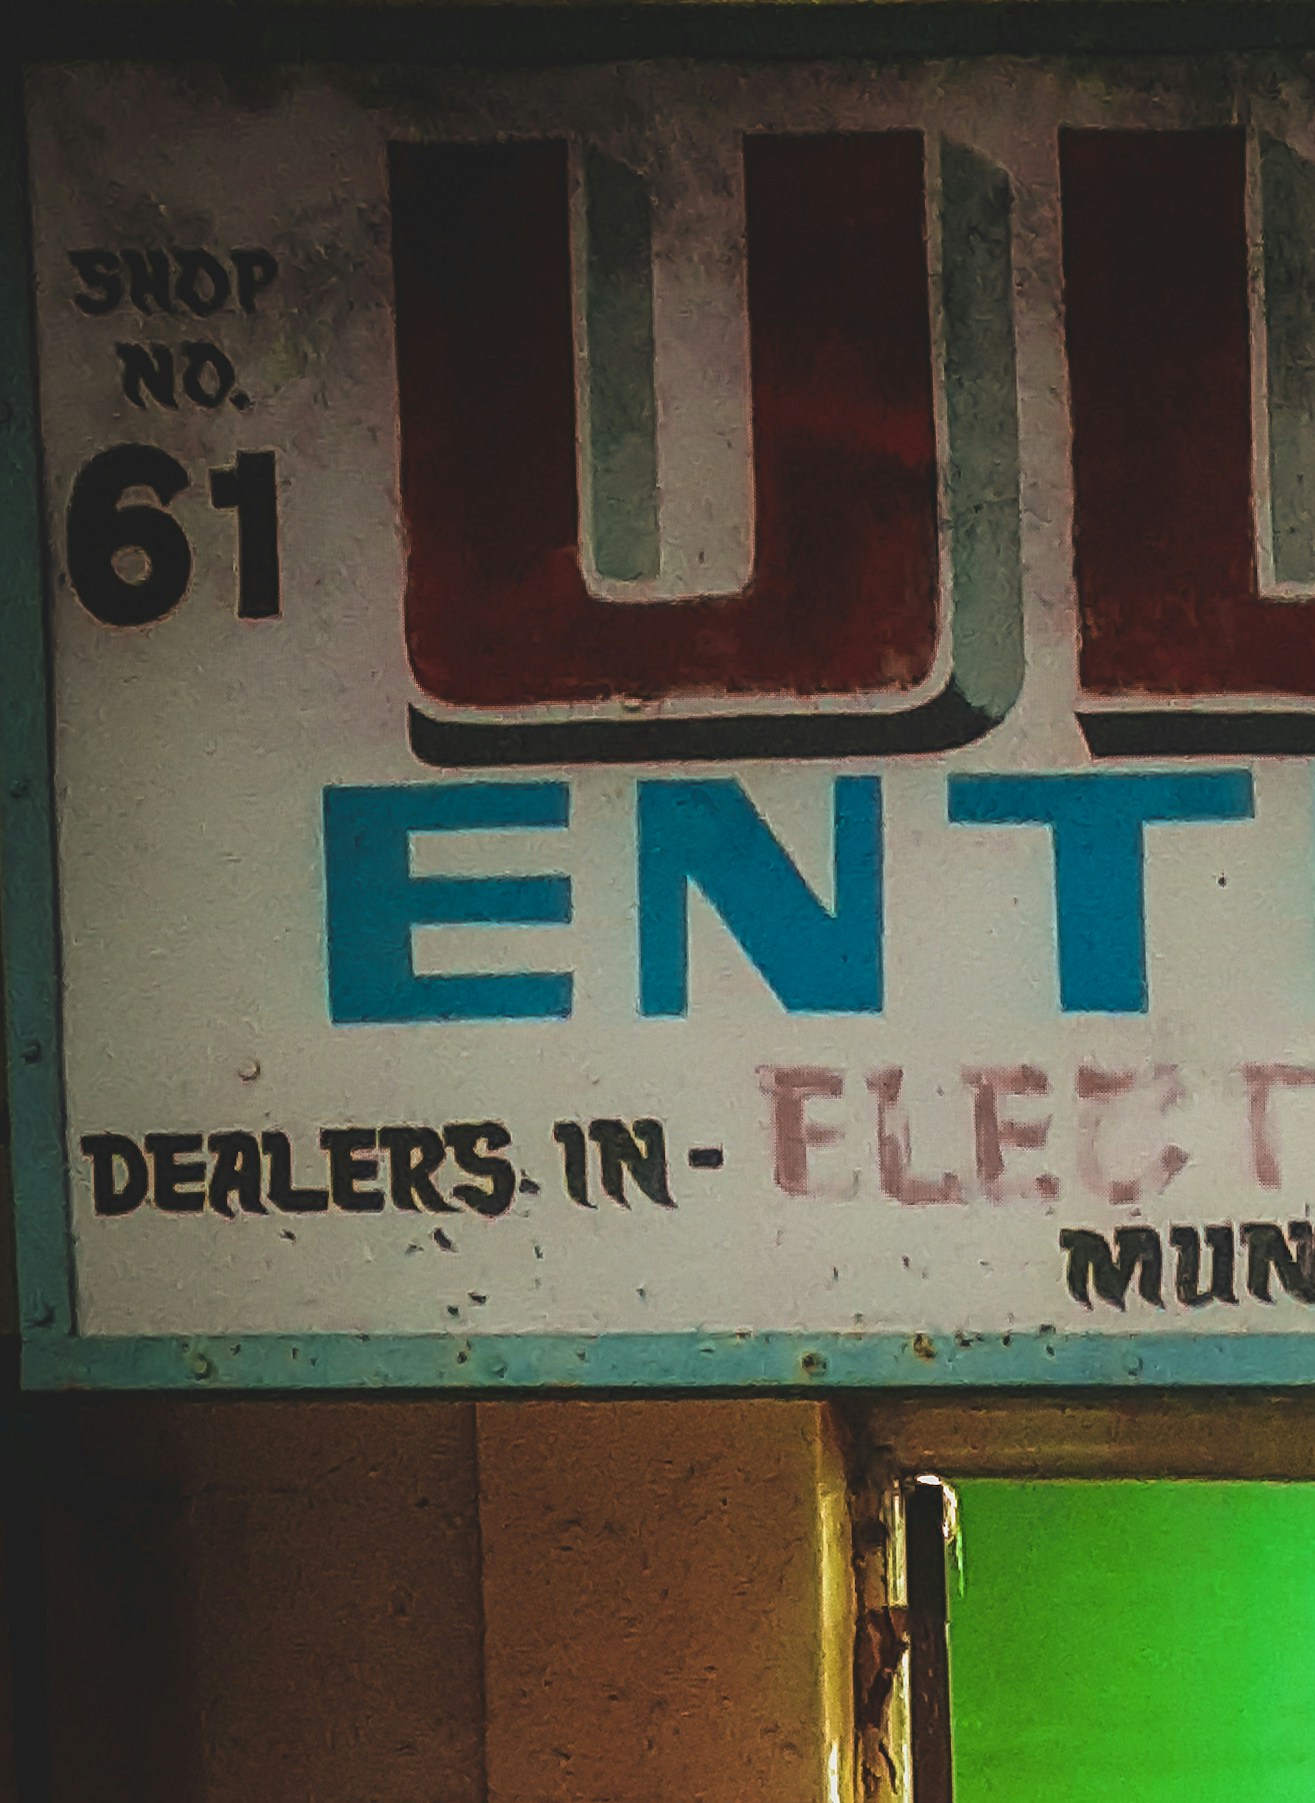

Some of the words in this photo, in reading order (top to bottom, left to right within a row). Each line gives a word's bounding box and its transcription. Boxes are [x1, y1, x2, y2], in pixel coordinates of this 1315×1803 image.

[67, 247, 279, 318] SHOP
[115, 340, 251, 411] NO.
[65, 443, 284, 627] 61
[81, 1119, 516, 1217] DEALERS
